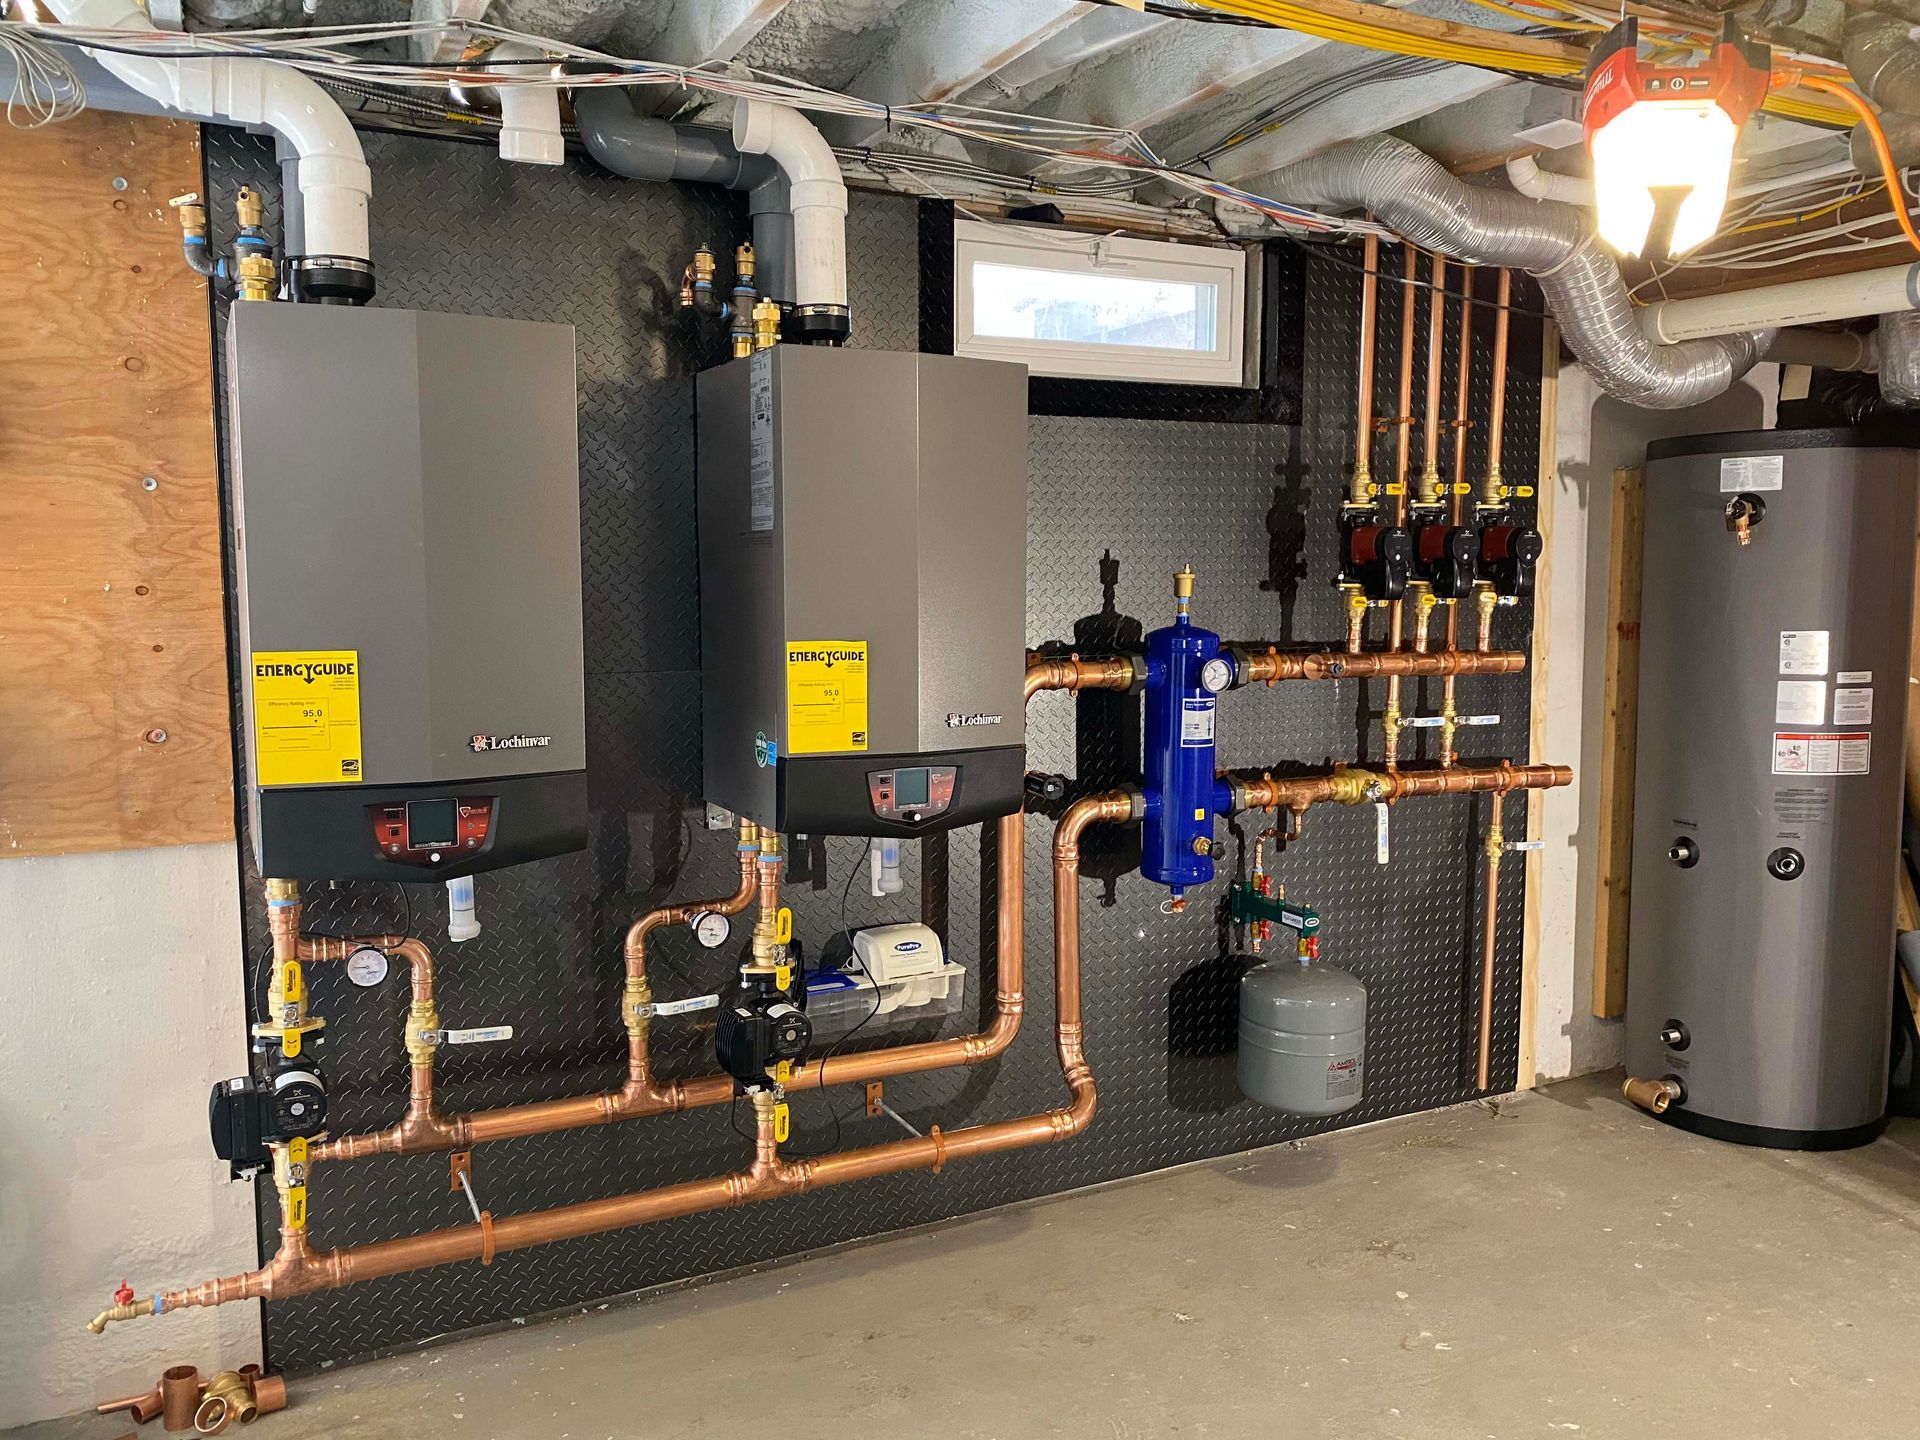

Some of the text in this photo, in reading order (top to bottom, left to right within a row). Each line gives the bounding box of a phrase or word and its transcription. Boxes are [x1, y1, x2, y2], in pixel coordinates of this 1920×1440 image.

[789, 651, 865, 666] ENERGYGUIDE
[256, 663, 354, 681] ENERGYGUIDE
[303, 709, 322, 717] 95.0
[961, 714, 1003, 726] Lochinvar
[490, 734, 551, 750] Lochinvar
[897, 943, 919, 951] PurePro
